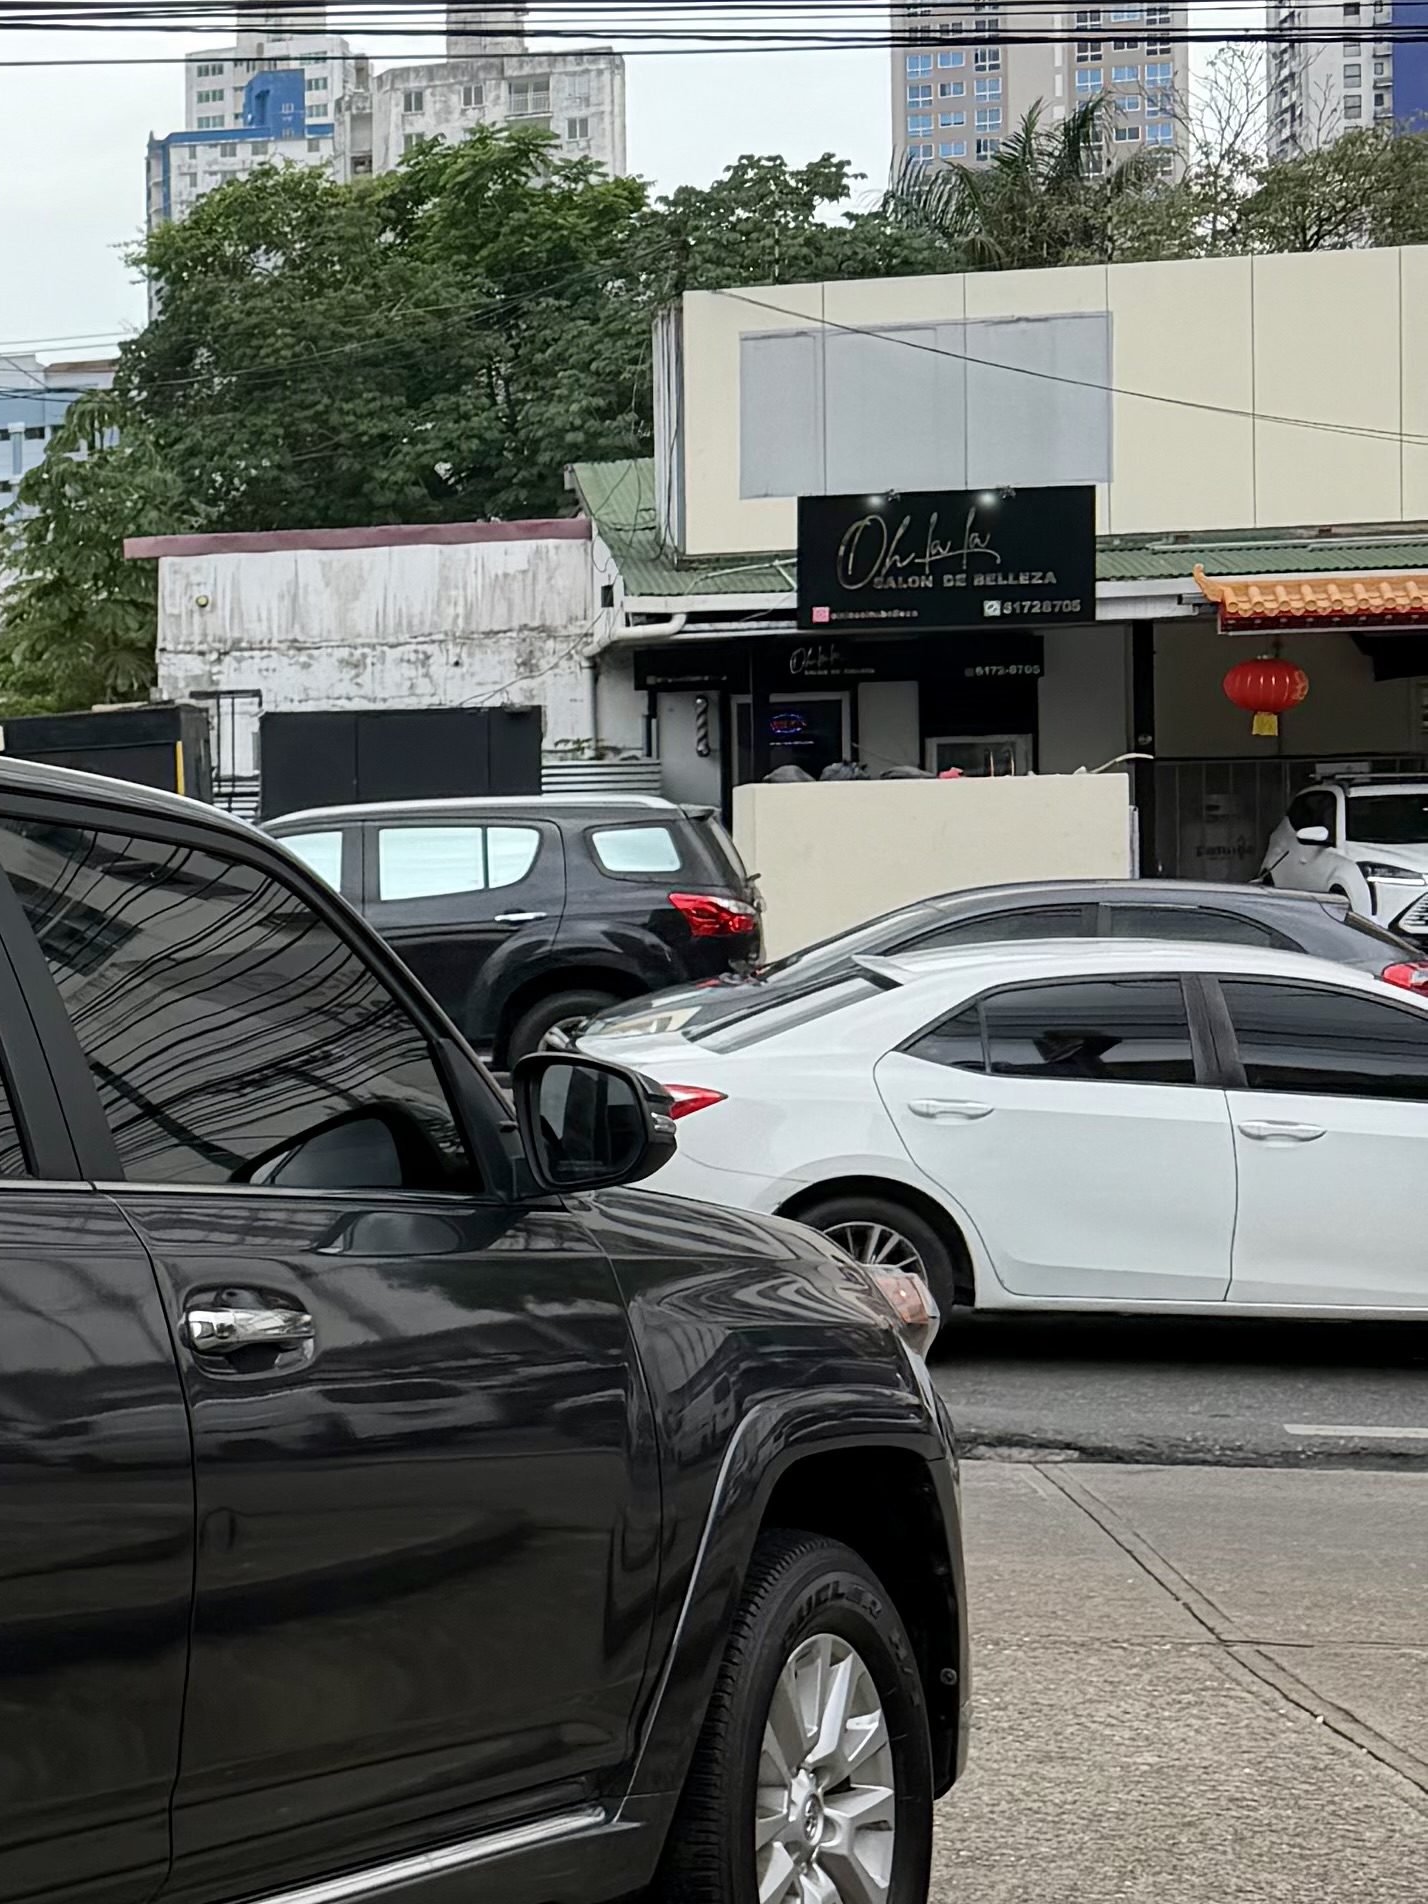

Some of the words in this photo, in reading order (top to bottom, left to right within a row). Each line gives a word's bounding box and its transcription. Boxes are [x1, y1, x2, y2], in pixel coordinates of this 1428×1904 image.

[836, 514, 915, 590] Oh
[873, 574, 934, 590] SALON
[942, 572, 968, 588] DE
[972, 571, 1058, 587] BELLEZA
